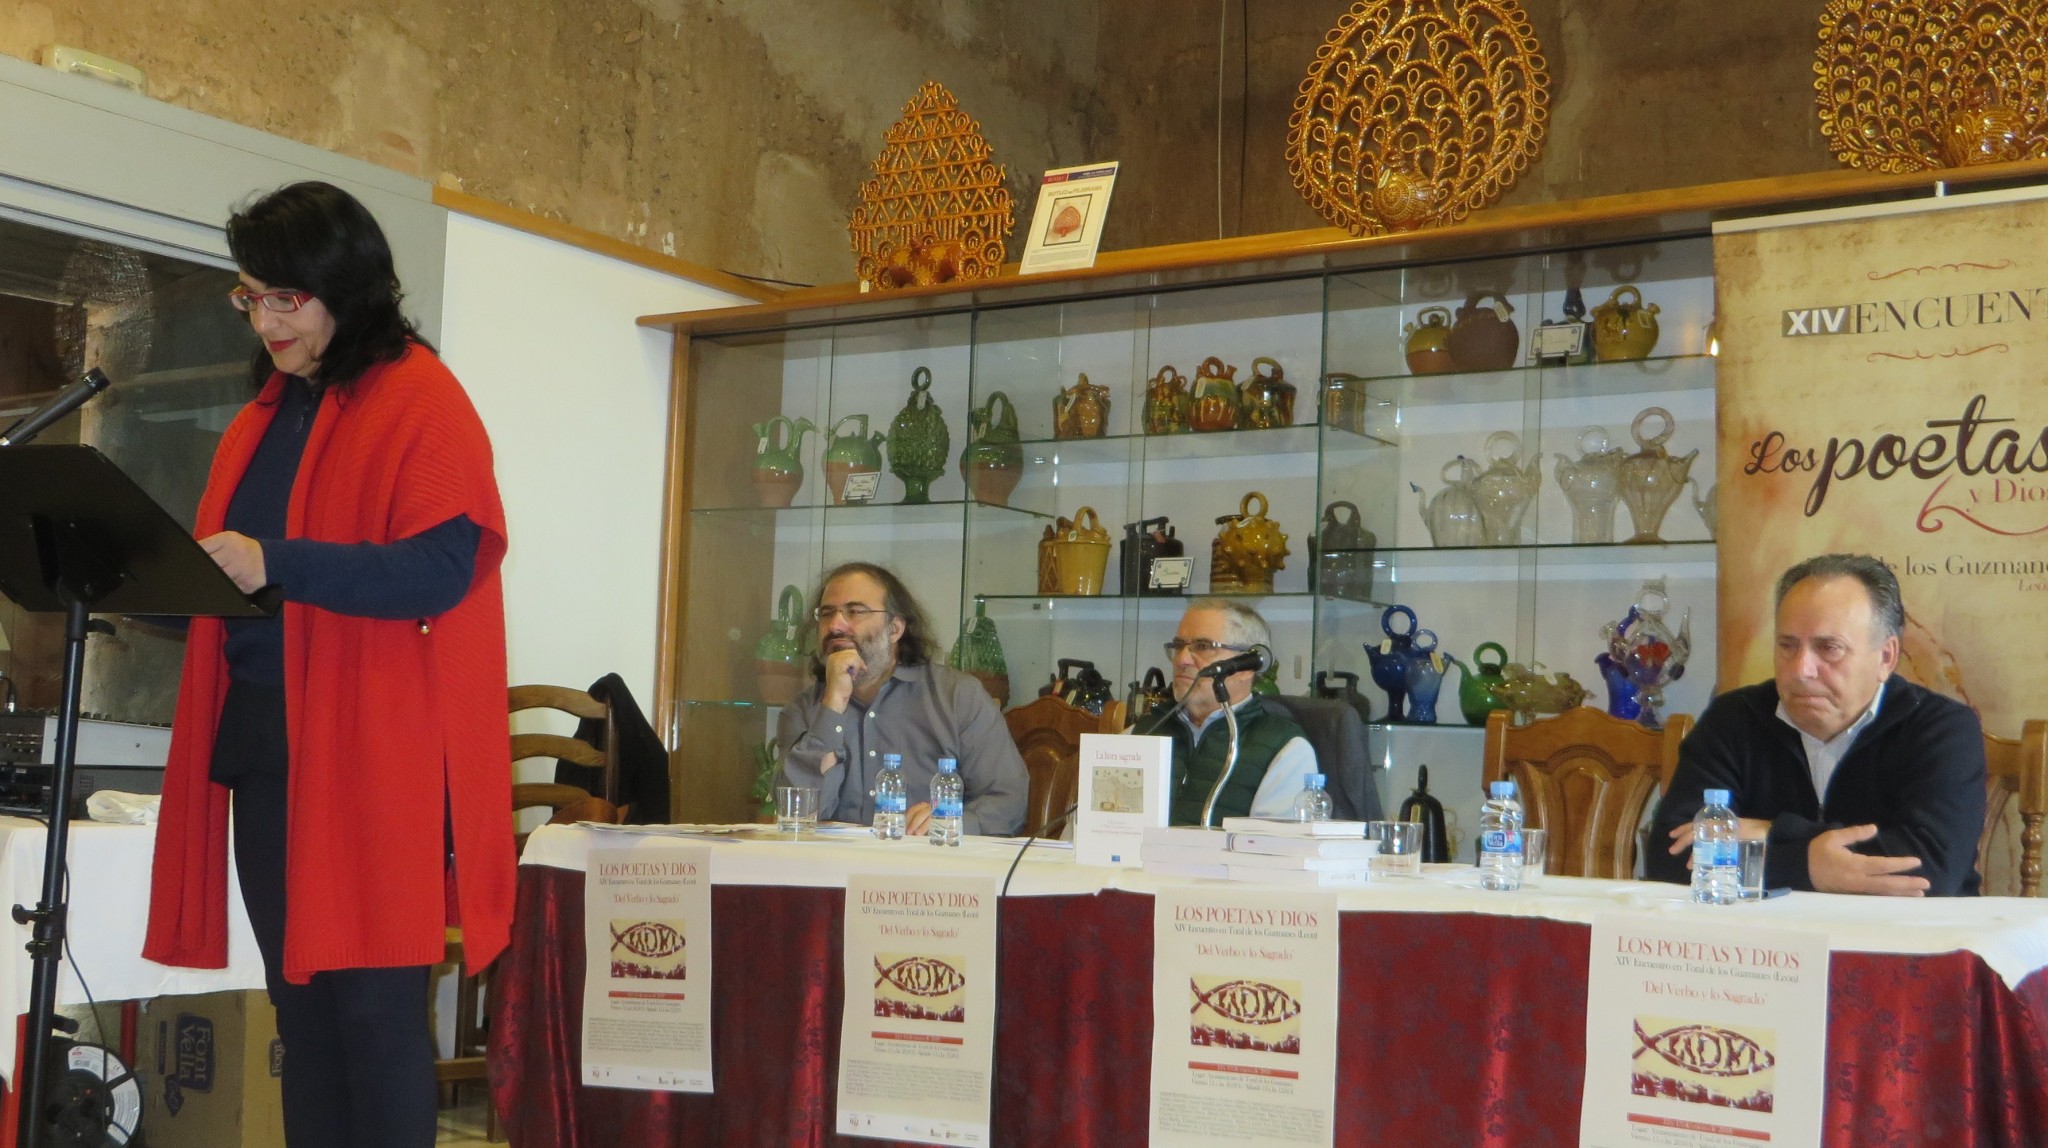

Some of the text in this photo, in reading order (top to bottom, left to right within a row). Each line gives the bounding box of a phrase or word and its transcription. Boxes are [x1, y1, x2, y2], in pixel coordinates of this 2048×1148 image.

[1787, 307, 1846, 335] XIV
[1744, 431, 1817, 475] Los
[1905, 555, 1937, 576] los
[600, 863, 697, 876] LOS POETAS Y DIOS
[862, 890, 979, 908] LOS POETAS Y DIOS
[1175, 905, 1318, 927] LOS POETAS Y DIOS
[1174, 923, 1185, 932] XIV
[1215, 944, 1241, 957] Verbo
[1617, 936, 1800, 969] LOS POETAS Y DIOS
[1616, 955, 1631, 966] XIV
[1666, 982, 1698, 997] Verbo
[180, 1024, 196, 1079] Vella
